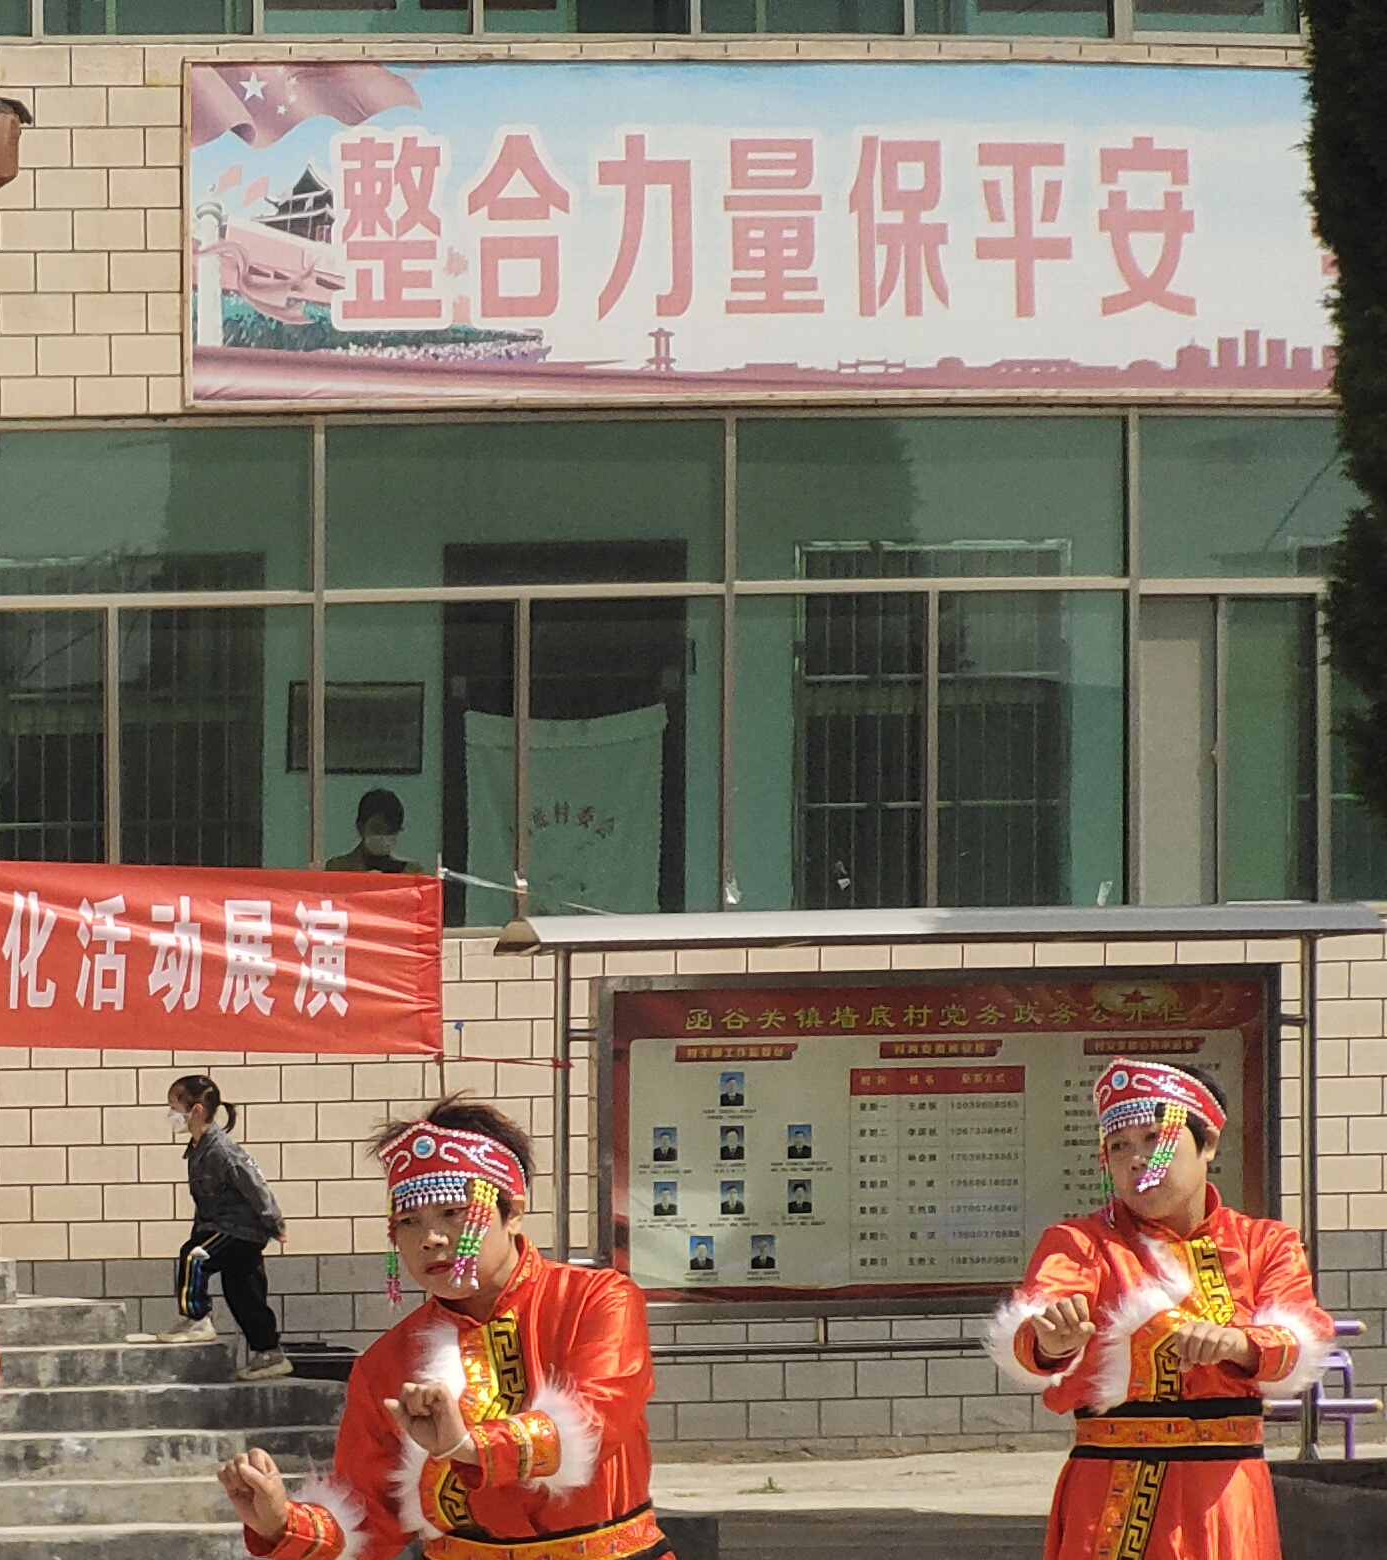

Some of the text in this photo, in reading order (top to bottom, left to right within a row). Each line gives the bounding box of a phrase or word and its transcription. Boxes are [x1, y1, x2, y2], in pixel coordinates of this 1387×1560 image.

[341, 135, 1197, 321] 整合力量保平安
